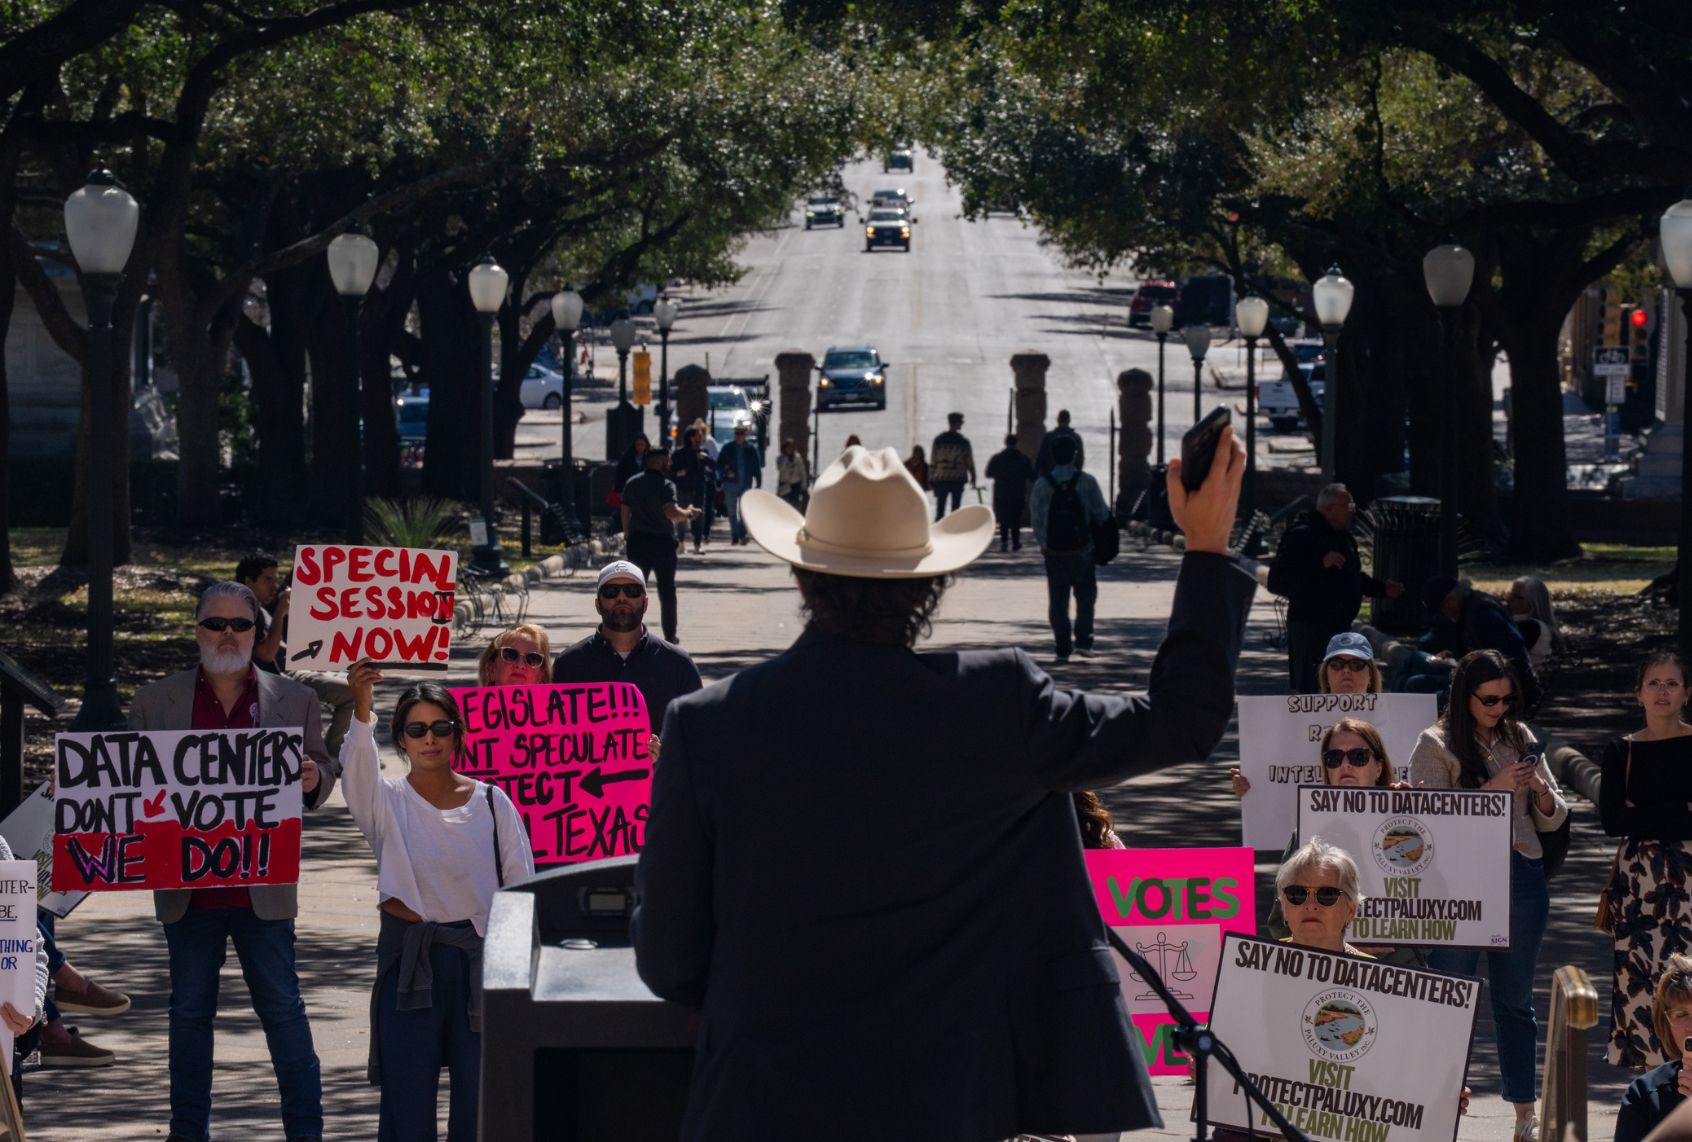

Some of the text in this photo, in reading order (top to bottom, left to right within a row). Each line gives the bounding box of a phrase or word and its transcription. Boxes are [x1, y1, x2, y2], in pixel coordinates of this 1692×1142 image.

[296, 546, 456, 590] SPECIAL
[309, 585, 455, 624] SESSION
[329, 624, 450, 663] NOW!
[462, 685, 639, 733] EGISLATE!!!
[1287, 693, 1377, 713] SUPPORT
[58, 729, 302, 788] DATA CENTERS
[509, 728, 649, 769] SPECULATE
[54, 788, 280, 834] DONT VOTE
[1310, 790, 1506, 817] SAY NO TO DATACENTERS!
[543, 803, 650, 857] TEXAS
[1380, 819, 1412, 834] PROTECT
[66, 833, 271, 885] WE DO!!
[1106, 876, 1240, 920] VOTES
[1383, 877, 1422, 899] VISIT
[1356, 897, 1482, 921] TECTPALUXY.COM
[1352, 918, 1457, 941] TO LEARN HOW
[1235, 940, 1473, 1009] SAY NO TO DATACENTERS!
[1315, 991, 1371, 1015] PROTECT THE
[1304, 1028, 1327, 1056] PALUXY
[1329, 1048, 1360, 1060] VALLEY
[1308, 1059, 1356, 1090] VISIT
[1345, 1117, 1391, 1142] HOW
